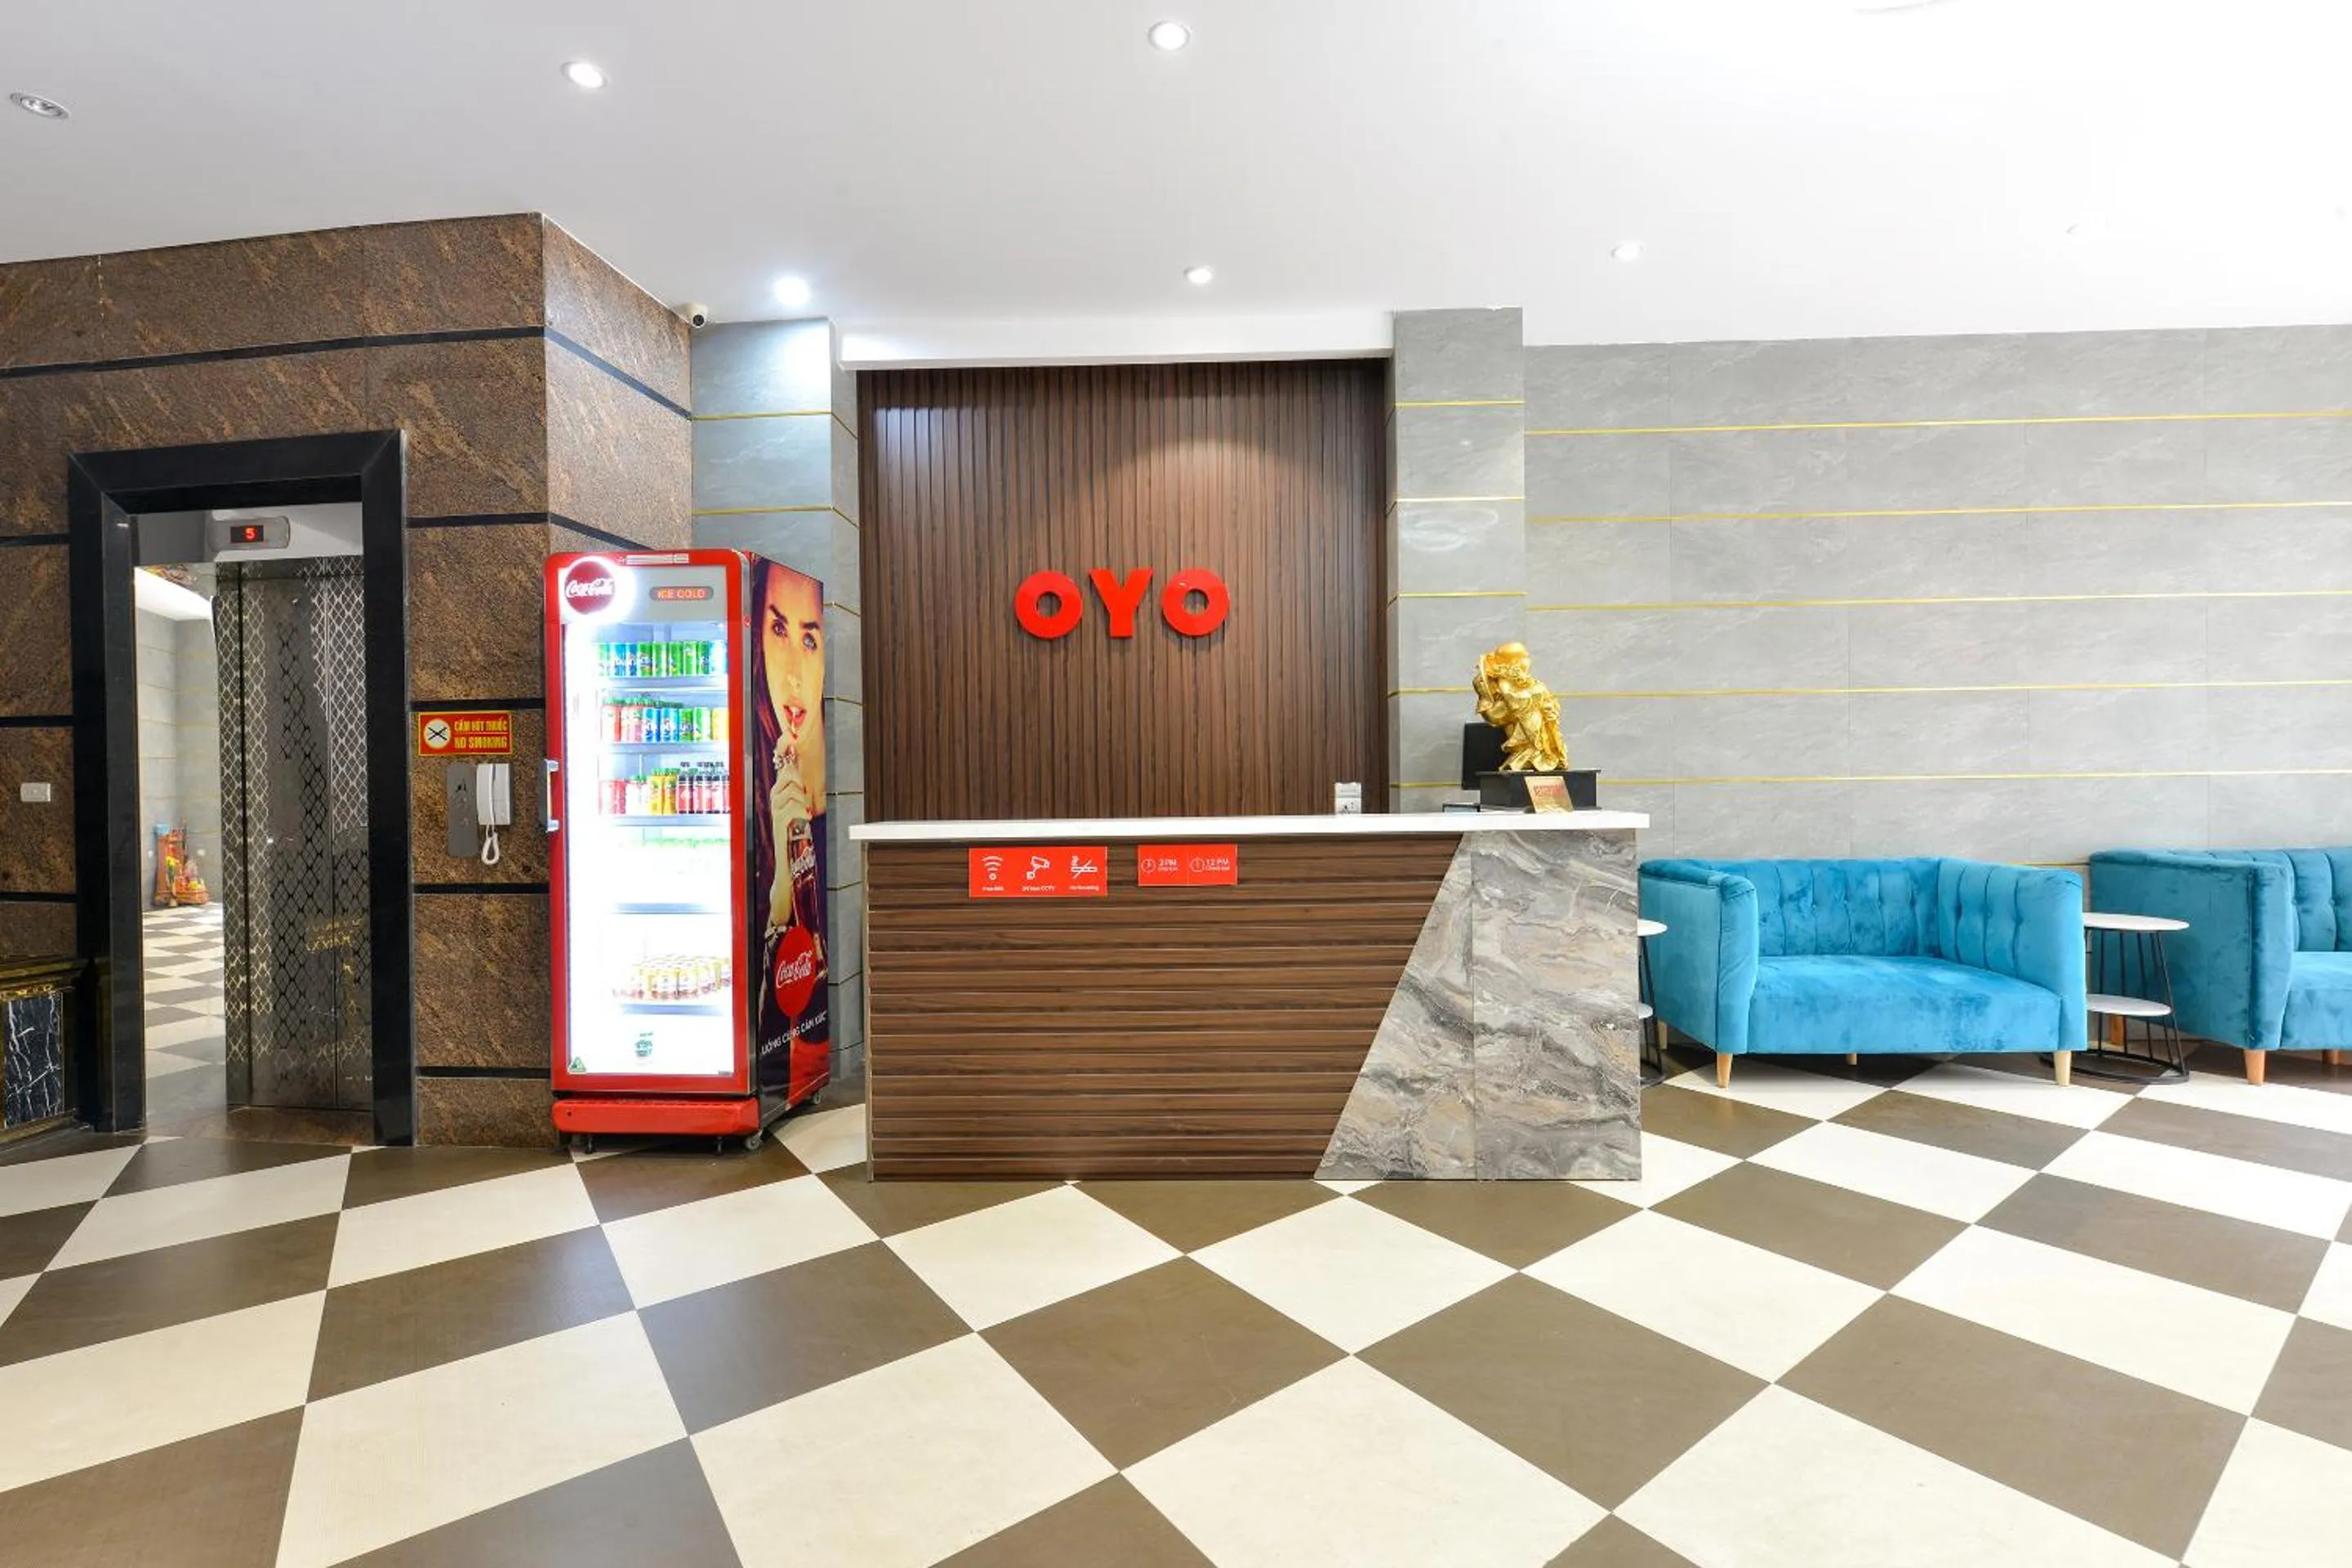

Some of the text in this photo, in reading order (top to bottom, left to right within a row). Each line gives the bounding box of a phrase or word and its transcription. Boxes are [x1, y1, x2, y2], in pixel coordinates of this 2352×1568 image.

[244, 528, 256, 540] 5
[657, 588, 706, 599] ICE COLD
[1015, 567, 1230, 639] OYO
[454, 736, 508, 749] NO SMOKING
[776, 950, 813, 989] Coca-Cola
